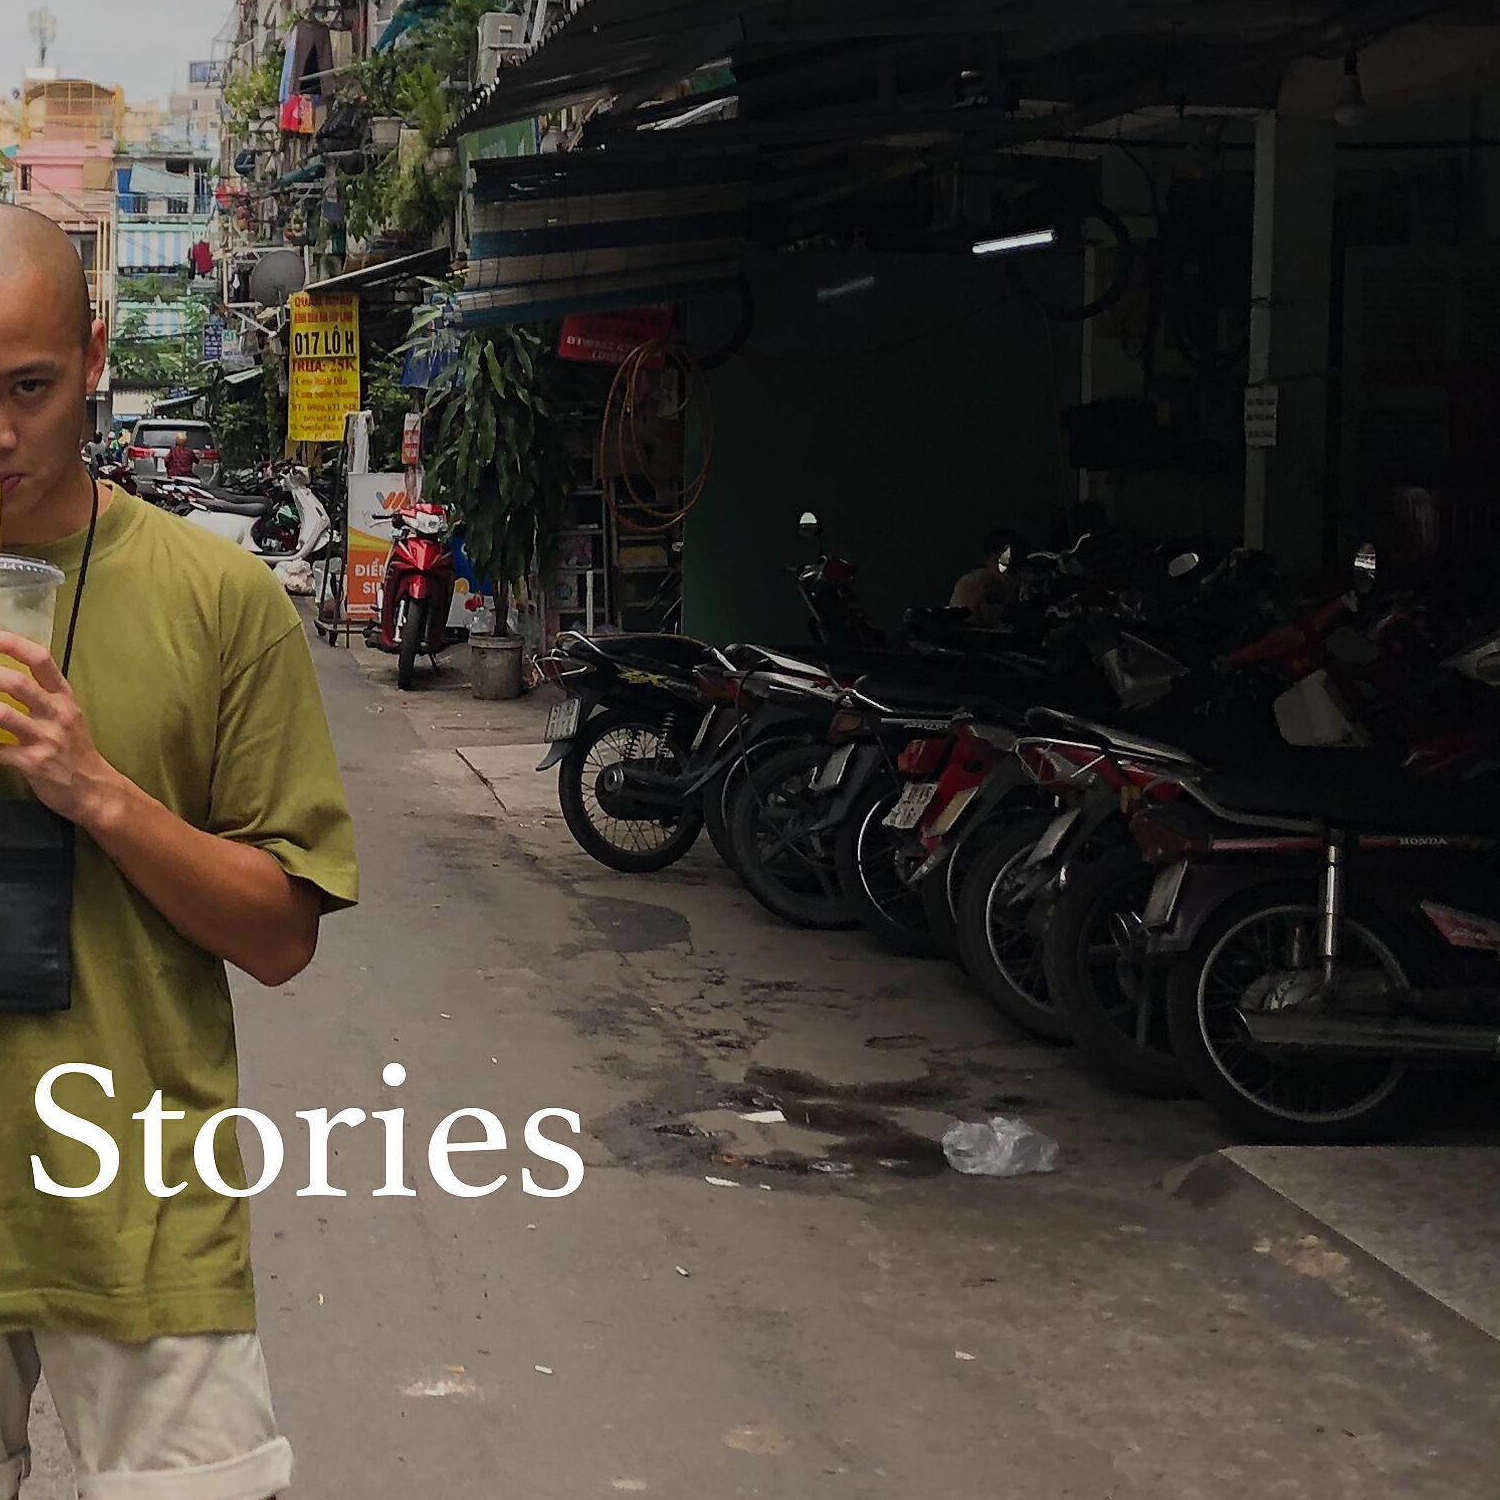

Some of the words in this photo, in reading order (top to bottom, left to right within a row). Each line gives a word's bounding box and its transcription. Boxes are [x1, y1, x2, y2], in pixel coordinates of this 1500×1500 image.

[295, 331, 319, 355] 017
[325, 325, 341, 355] LÔ
[345, 331, 354, 354] H
[1400, 837, 1447, 845] HONDA
